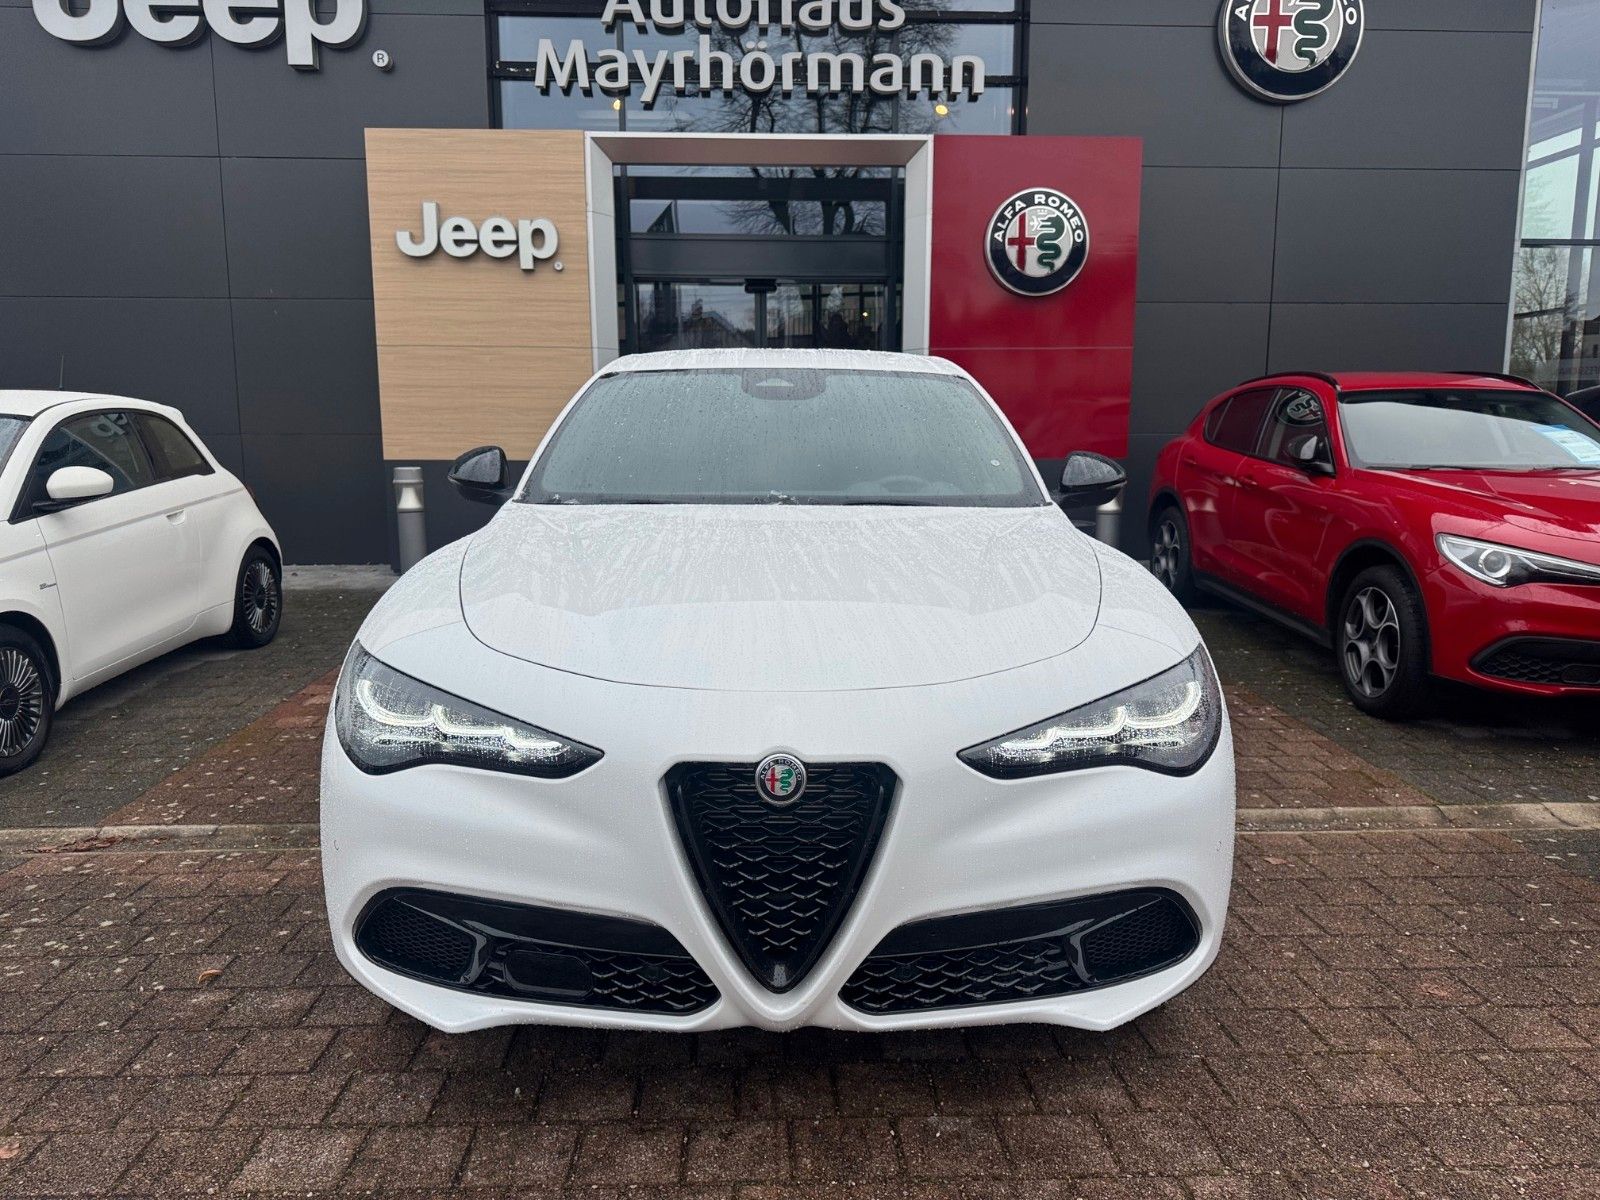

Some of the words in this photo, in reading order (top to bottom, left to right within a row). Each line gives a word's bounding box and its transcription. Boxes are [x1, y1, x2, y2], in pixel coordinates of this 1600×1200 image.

[534, 34, 985, 104] Mayrhörmann
[396, 202, 558, 270] Jeep
[993, 200, 1027, 243] ALFA
[1034, 194, 1084, 243] ROMEO
